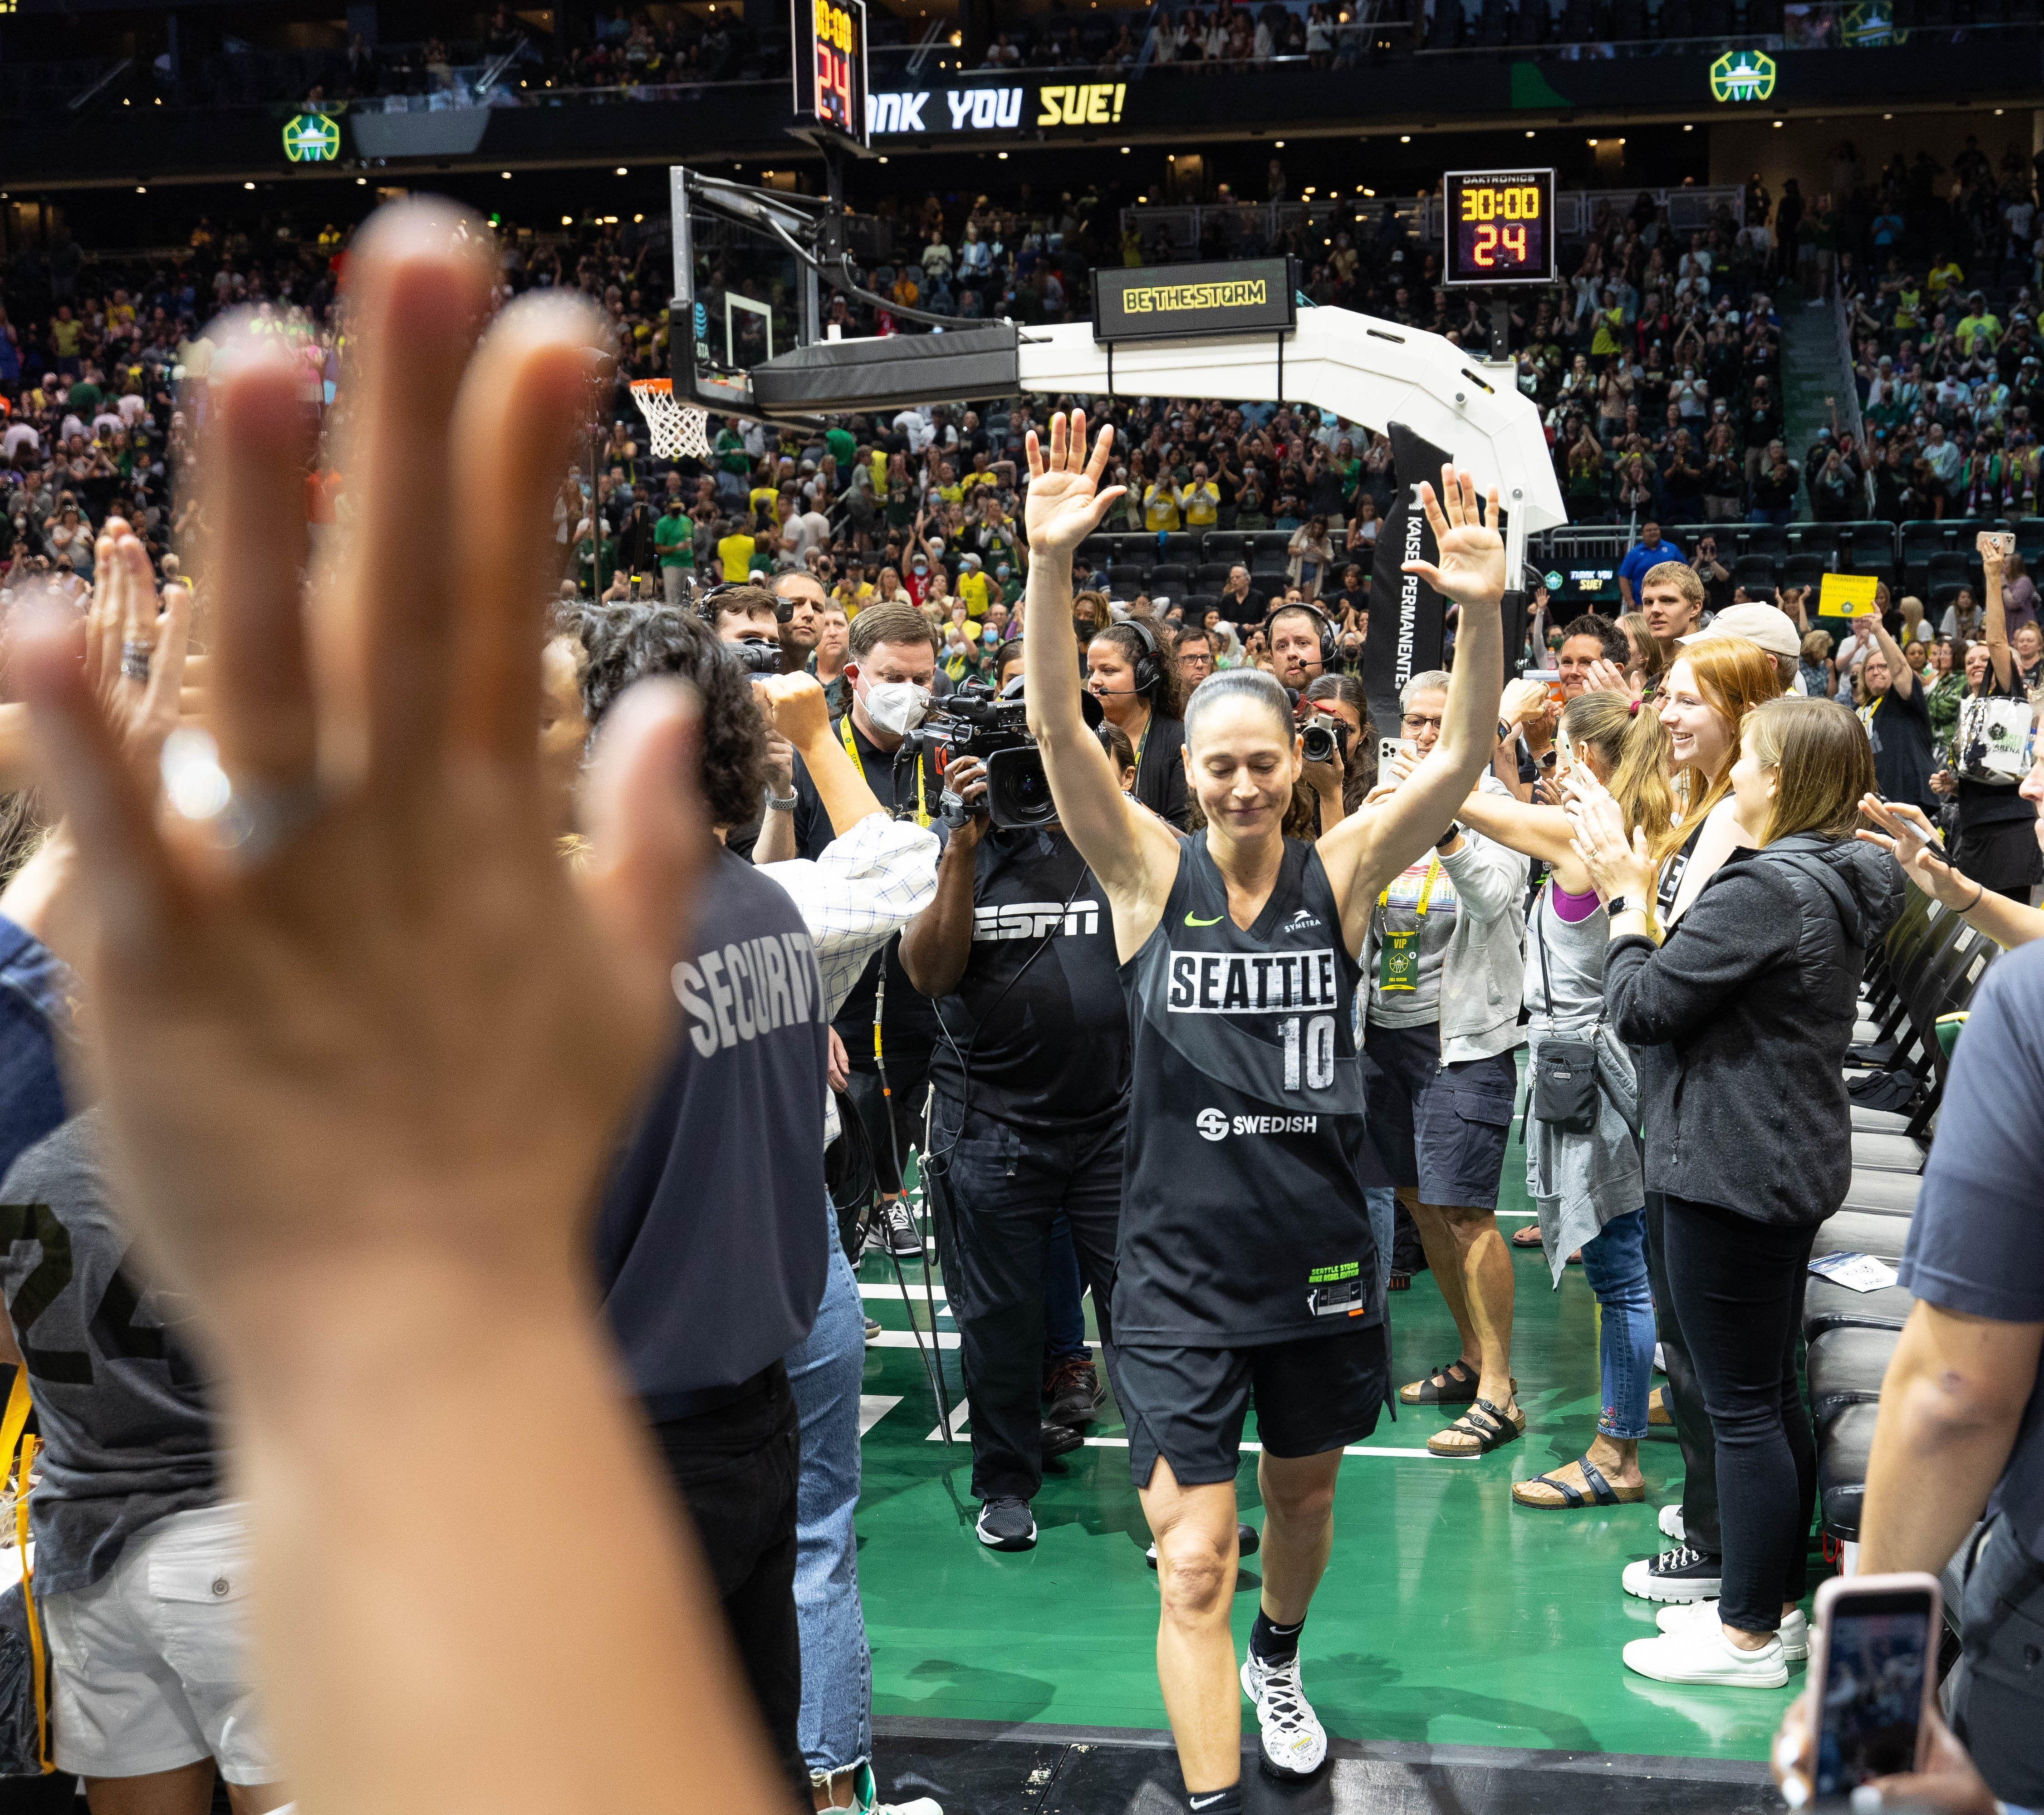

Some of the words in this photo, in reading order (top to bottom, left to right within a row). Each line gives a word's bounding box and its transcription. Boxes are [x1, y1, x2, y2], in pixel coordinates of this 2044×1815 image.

[816, 43, 850, 126] 24
[868, 92, 930, 133] ANK
[947, 88, 1023, 129] YOU
[1037, 83, 1126, 127] SUE!
[1462, 175, 1535, 184] DAKTRONICS
[1461, 187, 1539, 221] 30:00
[1473, 224, 1527, 266] 24
[1405, 516, 1422, 562] KAISE
[1570, 570, 1595, 580] THANK
[1597, 570, 1613, 580] YOU
[1579, 579, 1603, 590] SUE!
[1395, 575, 1418, 683] PERMANENTE
[1995, 744, 2020, 755] ARENA
[1427, 861, 1439, 884] SEATTLE
[1421, 885, 1431, 903] STORM
[971, 900, 1099, 941] ESPN
[1284, 918, 1321, 933] SYMETRA
[1394, 938, 1407, 949] VIP
[1172, 954, 1334, 1009] SEATTLE
[1276, 1014, 1336, 1091] 10
[1233, 1115, 1317, 1135] SWEDISH
[1309, 1275, 1323, 1283] NIKE
[1340, 1268, 1359, 1279] EDITION
[1311, 1266, 1339, 1275] SEATTLE
[1340, 1261, 1358, 1271] STORM
